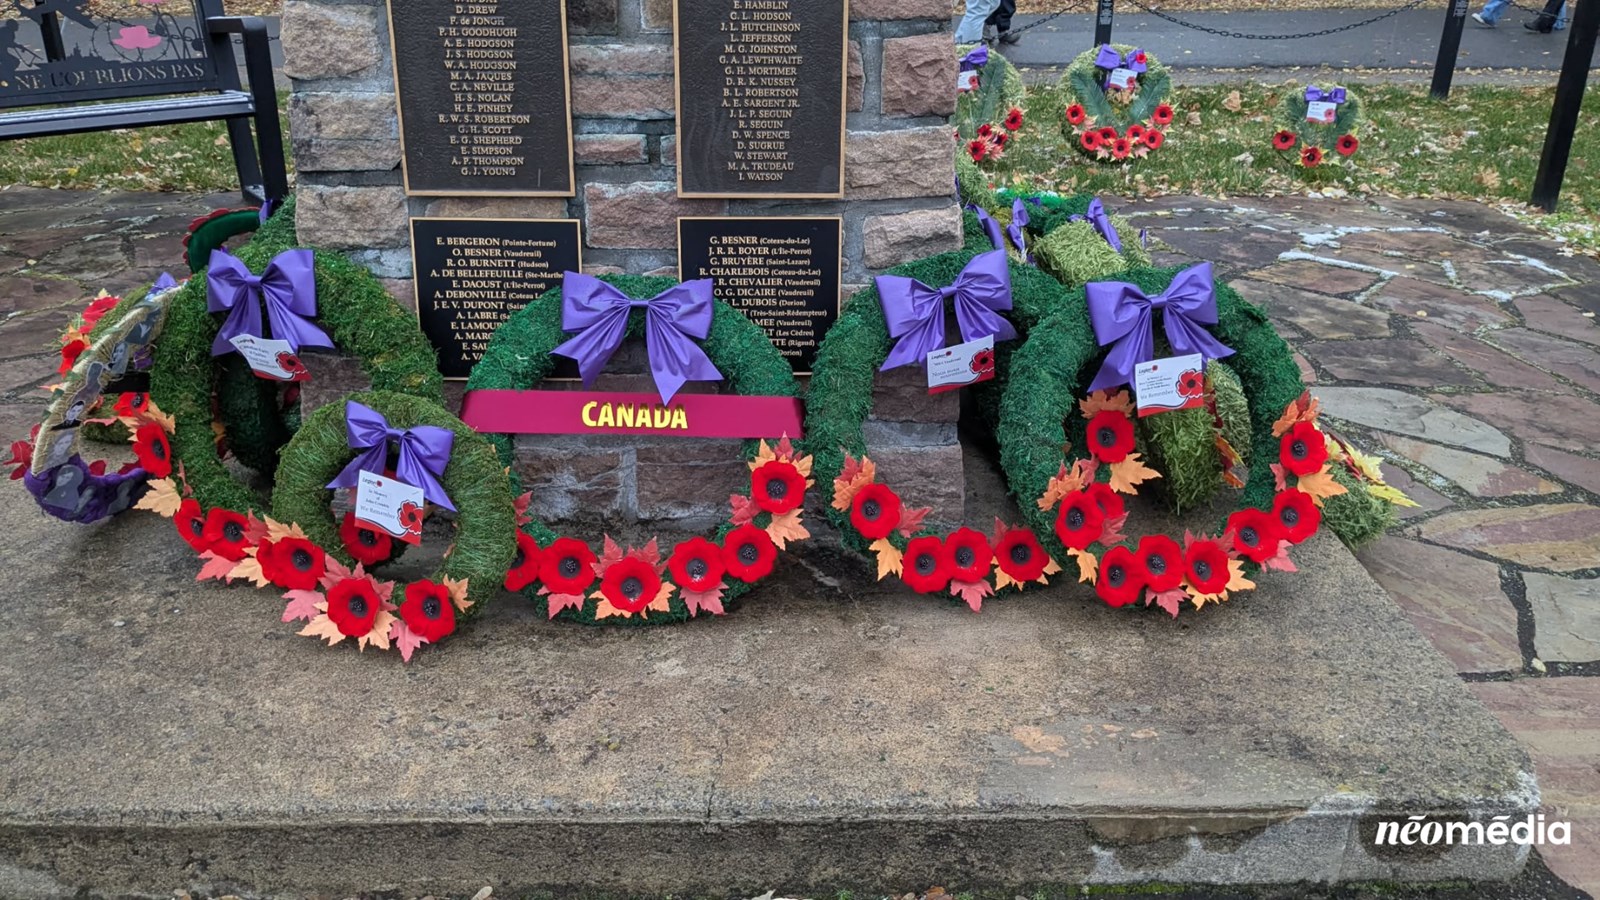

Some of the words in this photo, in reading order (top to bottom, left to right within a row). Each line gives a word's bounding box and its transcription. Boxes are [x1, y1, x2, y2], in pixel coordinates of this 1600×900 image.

[460, 16, 471, 24] de
[472, 16, 504, 24] JONGH
[730, 23, 739, 31] L.
[740, 23, 800, 31] HUTCHINSON
[730, 34, 739, 42] L.
[740, 34, 791, 42] JEFFERSON
[444, 39, 454, 47] A.
[455, 39, 465, 47] E.
[466, 39, 514, 47] HODGSON
[724, 44, 736, 53] M.
[737, 44, 748, 53] G.
[749, 44, 797, 53] JOHNSTON
[719, 56, 729, 64] G.
[730, 56, 740, 64] A.
[741, 56, 803, 64] LEWTHWAITE
[725, 66, 735, 74] G.
[736, 66, 746, 74] H.
[747, 66, 797, 74] MORTIMER
[15, 74, 46, 91] NE
[170, 63, 204, 80] PAS
[450, 72, 462, 81] M.
[464, 72, 474, 81] A.
[475, 72, 512, 81] JAQUES
[450, 83, 460, 91] C.
[461, 83, 472, 91] A.
[473, 83, 514, 91] NEVILLE
[439, 115, 448, 123] R.
[450, 115, 462, 123] W.
[464, 115, 472, 123] S.
[474, 115, 530, 123] ROBERTSON
[452, 157, 462, 165] A.
[463, 157, 471, 165] P.
[472, 157, 524, 165] THOMPSON
[461, 167, 472, 175] G.
[482, 167, 516, 175] YOUNG
[452, 248, 462, 256] O.
[464, 248, 501, 256] BESNER
[722, 256, 764, 265] BRUYÈRE
[430, 269, 440, 277] A.
[442, 269, 454, 277] DE
[457, 269, 523, 277] BELLEFEUILLE
[788, 339, 815, 347] (Rigaud)
[582, 401, 688, 428] CANADA
